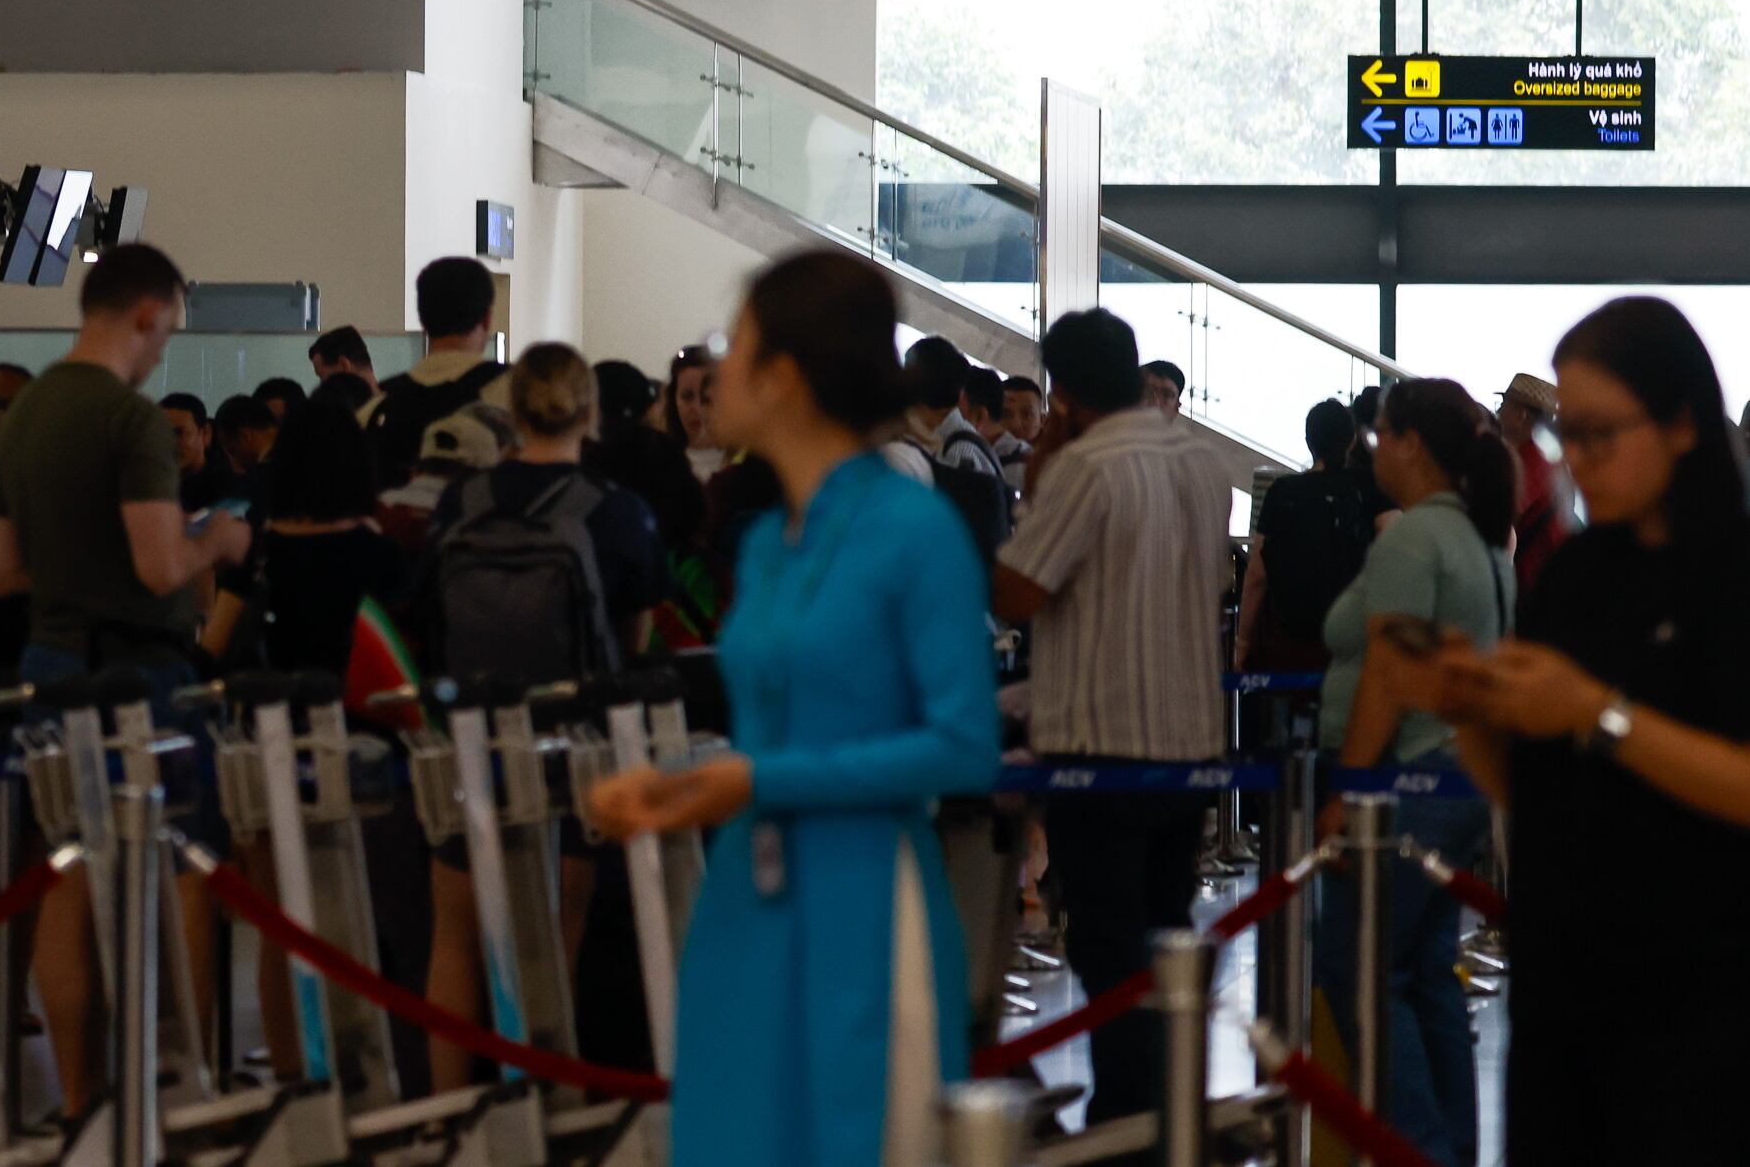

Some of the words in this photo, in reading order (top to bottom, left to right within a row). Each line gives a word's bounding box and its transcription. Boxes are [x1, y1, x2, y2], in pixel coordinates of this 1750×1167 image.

[1528, 62, 1565, 78] Hành
[1513, 80, 1580, 96] Oversized
[1584, 80, 1642, 99] baggage
[1611, 110, 1642, 125] sinh
[1597, 127, 1640, 143] Toilets
